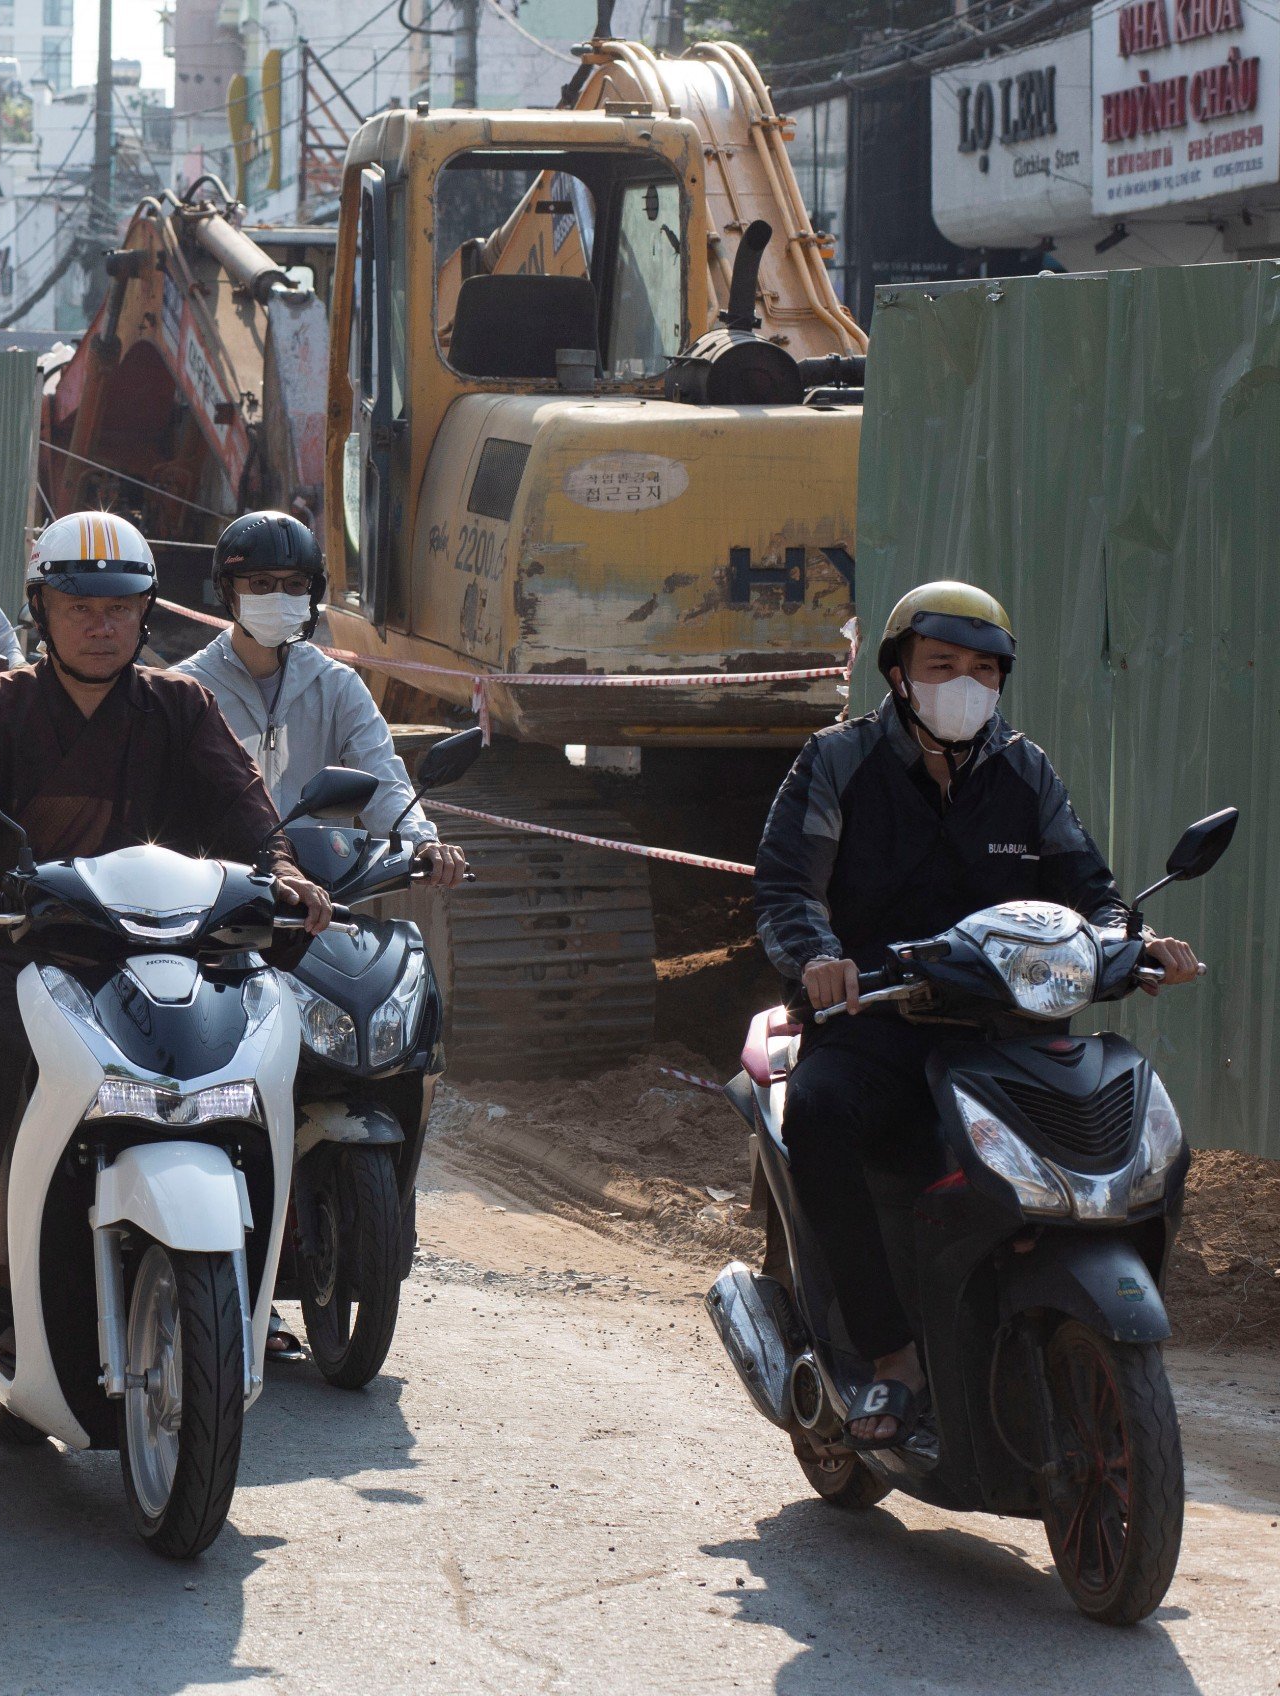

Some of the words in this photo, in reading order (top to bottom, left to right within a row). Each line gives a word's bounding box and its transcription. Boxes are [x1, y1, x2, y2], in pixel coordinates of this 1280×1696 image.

[1117, 0, 1171, 58] NHA
[1174, 0, 1244, 44] KHOA
[956, 81, 994, 175] LỌ
[998, 64, 1057, 145] LEM
[1055, 148, 1080, 170] Store
[586, 485, 661, 503] 접근금지
[145, 959, 185, 967] HONDA
